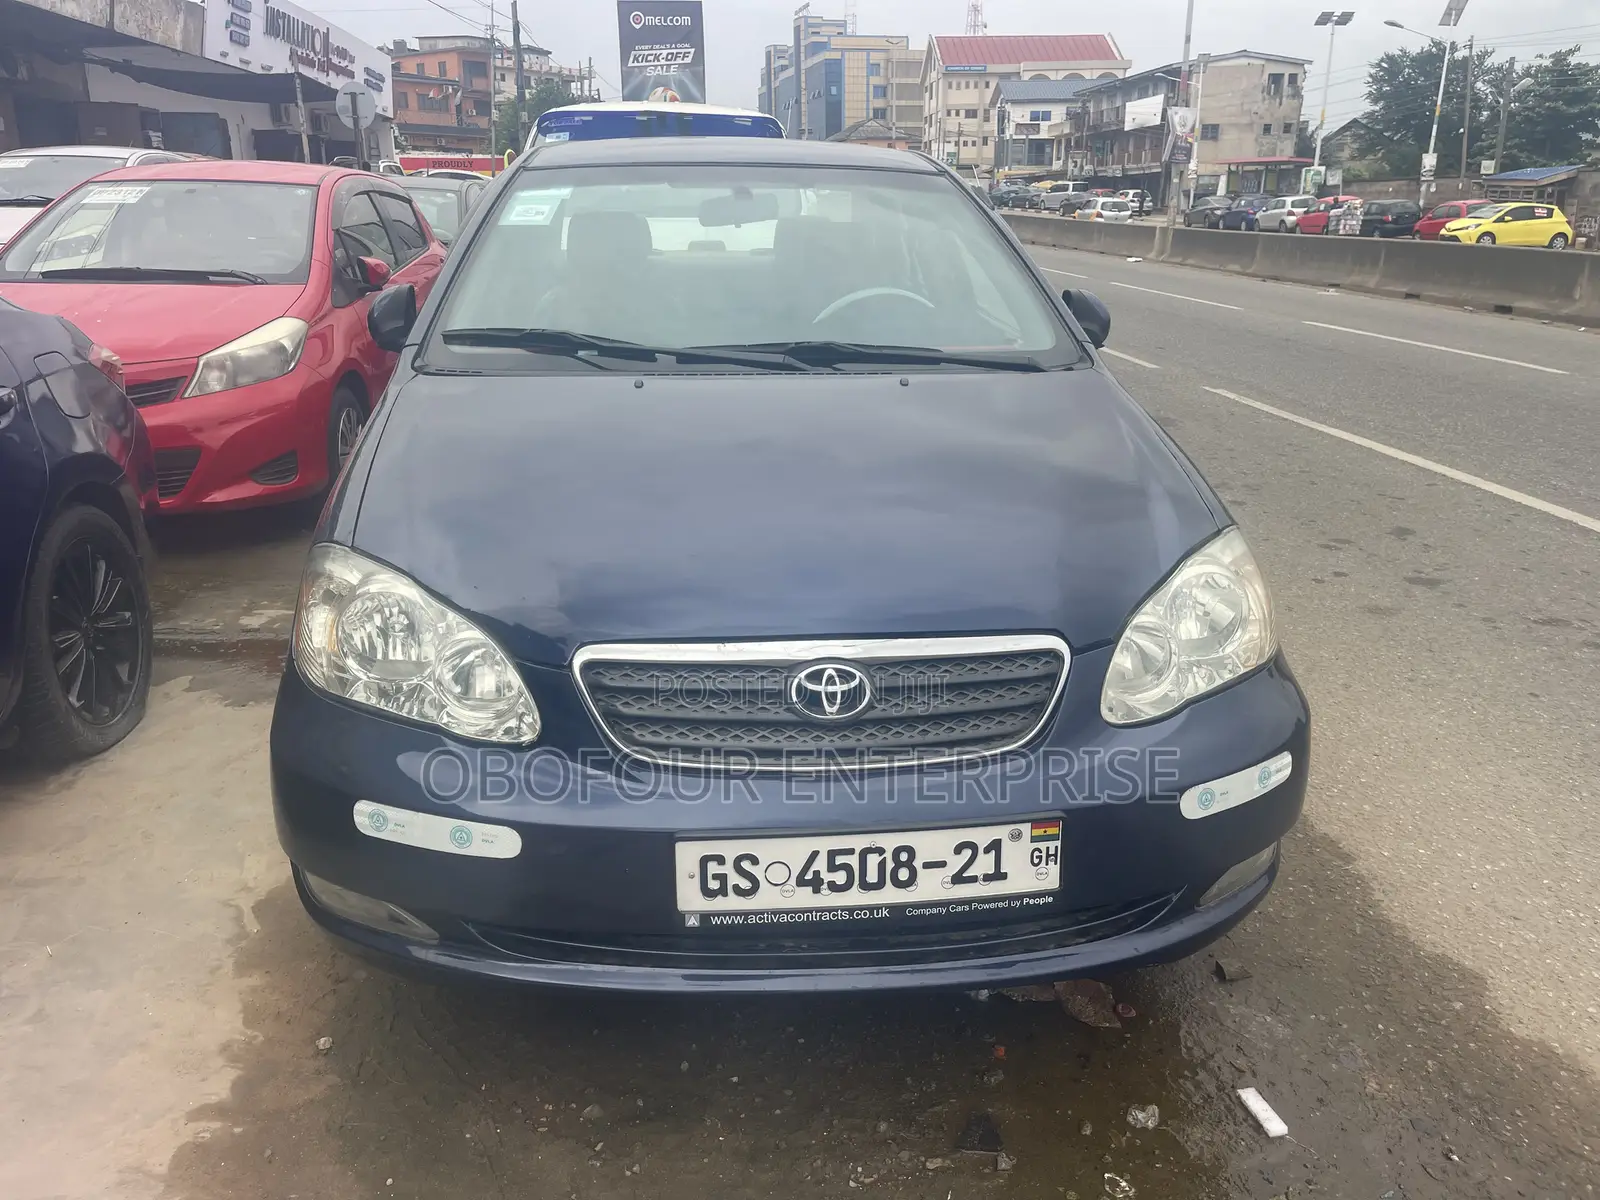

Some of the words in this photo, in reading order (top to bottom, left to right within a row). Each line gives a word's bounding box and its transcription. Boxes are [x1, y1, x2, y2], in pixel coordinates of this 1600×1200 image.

[645, 16, 691, 26] MELCOM
[632, 51, 692, 64] KICK-OFF
[646, 65, 678, 76] SALE
[432, 160, 474, 168] PROUDLY
[1030, 845, 1058, 868] GH
[699, 852, 761, 898] GS
[795, 838, 1008, 894] 4508-21
[906, 906, 947, 917] Company
[949, 904, 970, 912] Cars
[971, 899, 1009, 910] Powered
[1023, 895, 1054, 906] People
[710, 907, 890, 926] www.activacontracts.co.uk
